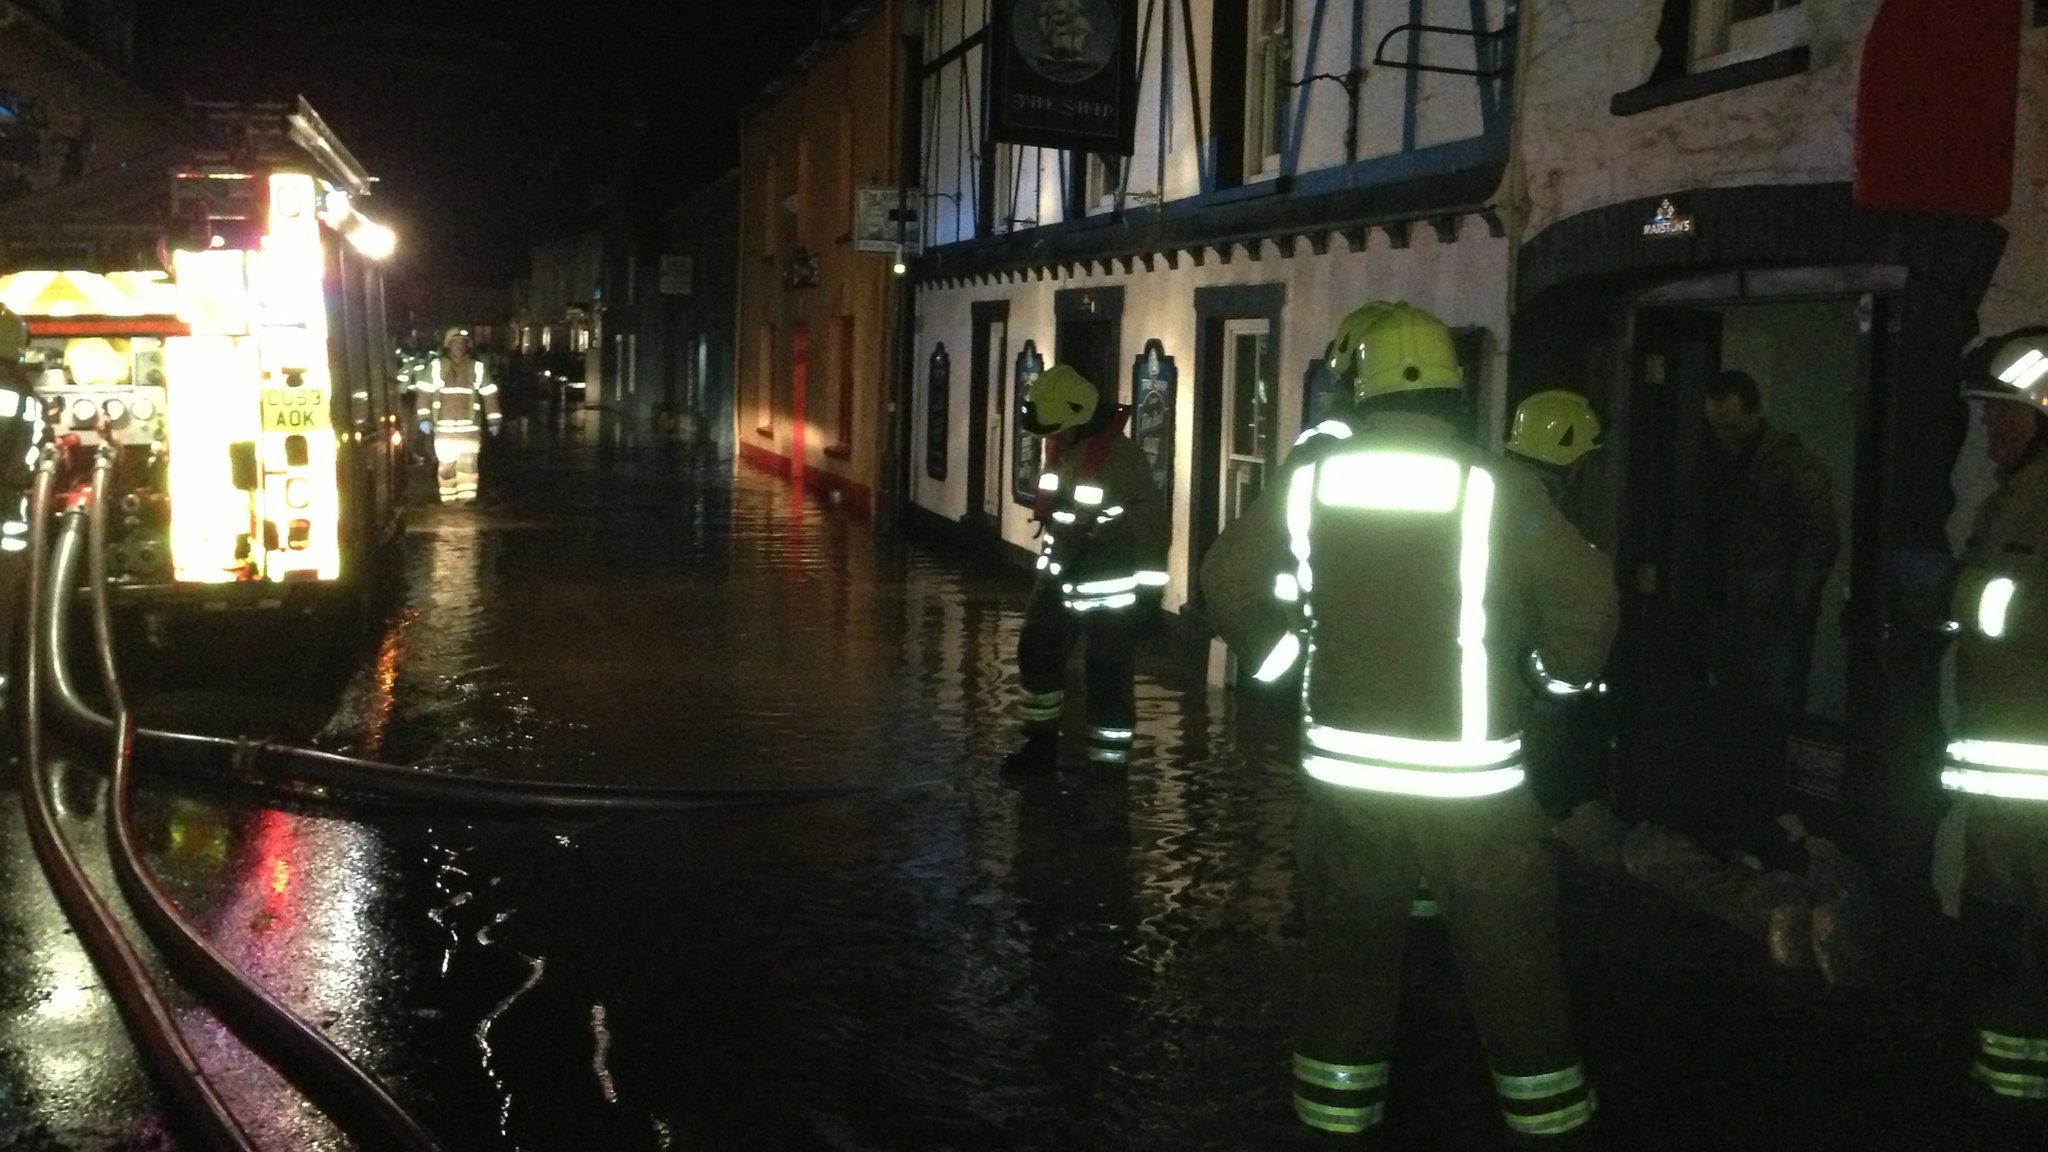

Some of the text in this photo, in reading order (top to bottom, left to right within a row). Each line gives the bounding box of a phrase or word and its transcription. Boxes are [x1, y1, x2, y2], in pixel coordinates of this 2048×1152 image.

[1013, 93, 1114, 117] THE SHIP
[276, 410, 314, 426] AOK
